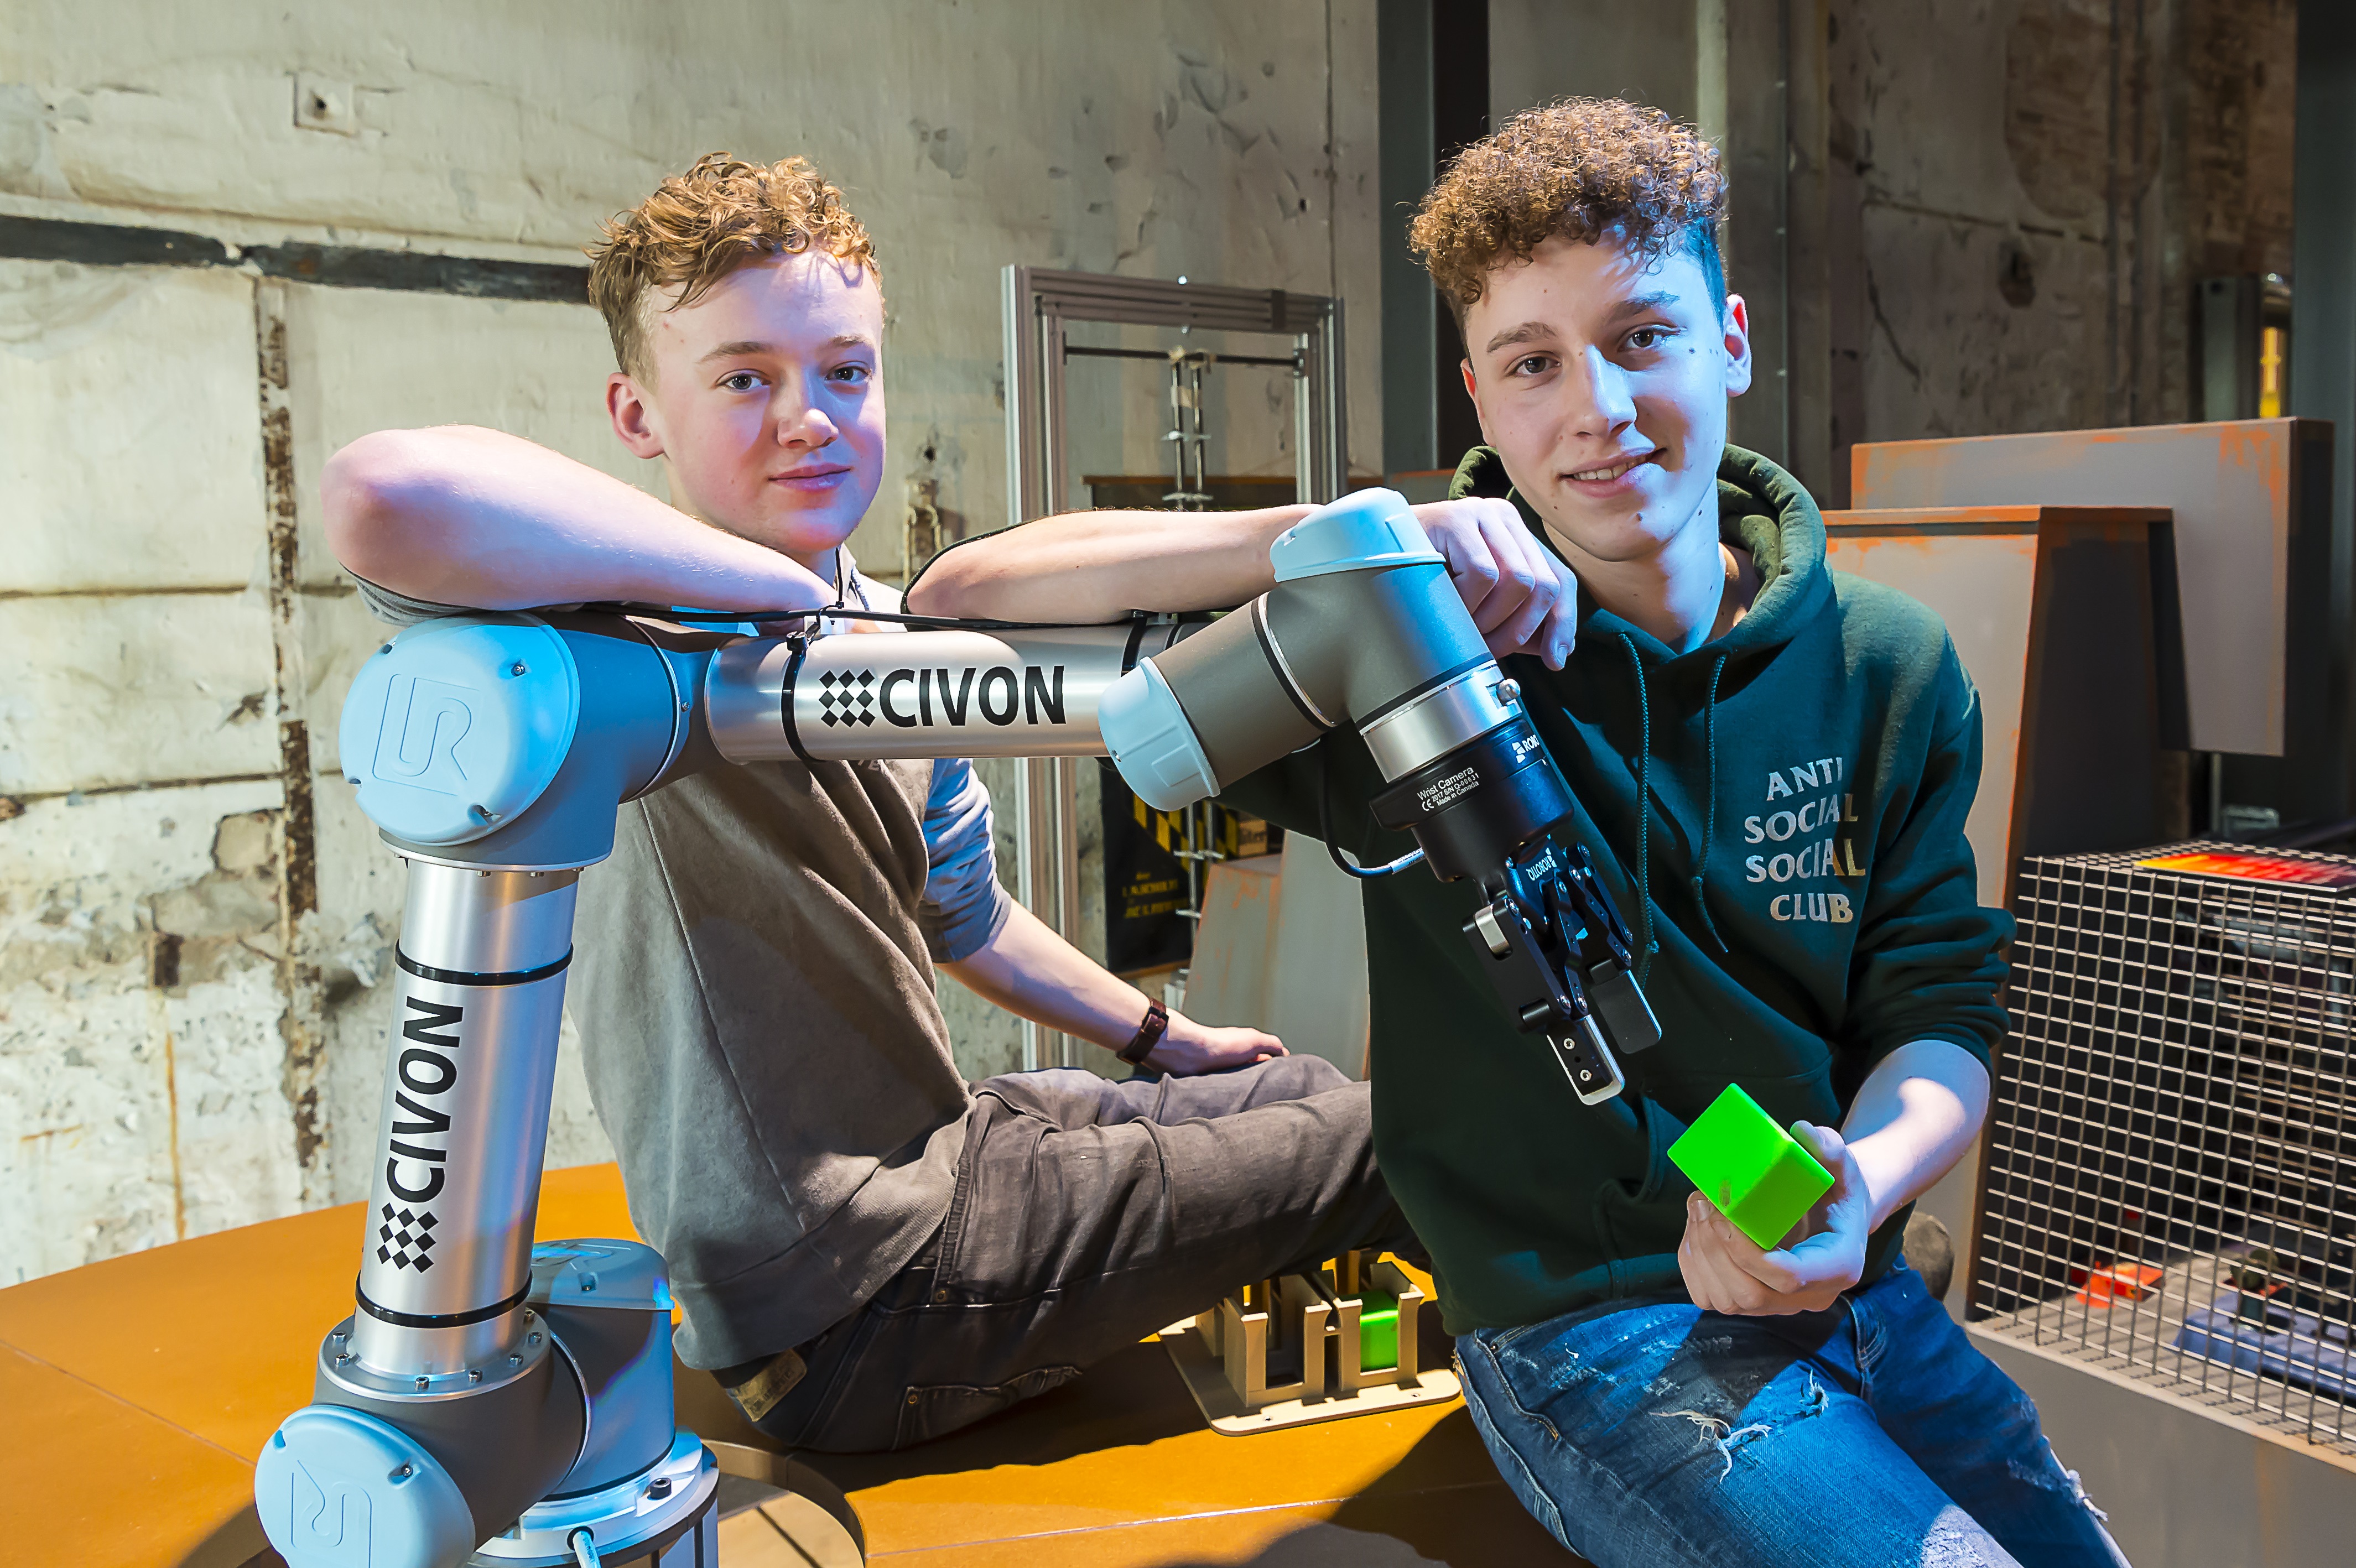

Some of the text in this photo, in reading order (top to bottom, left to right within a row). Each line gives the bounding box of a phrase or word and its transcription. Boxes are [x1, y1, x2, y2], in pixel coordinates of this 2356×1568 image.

[880, 665, 1067, 728] CIVON
[1522, 734, 1540, 752] ROBO
[1417, 767, 1474, 800] Wrist Camera
[1432, 791, 1443, 802] 2017
[1444, 786, 1454, 795] S/N
[1437, 796, 1451, 806] Made
[1457, 781, 1479, 795] Canada
[1766, 757, 1843, 801] ANTI
[1744, 793, 1858, 843] SOCIAL
[1526, 857, 1552, 881] ROBOTIQ
[1745, 838, 1866, 882] SOCIAL
[1770, 893, 1853, 923] CLUB
[386, 996, 464, 1203] CIVON
